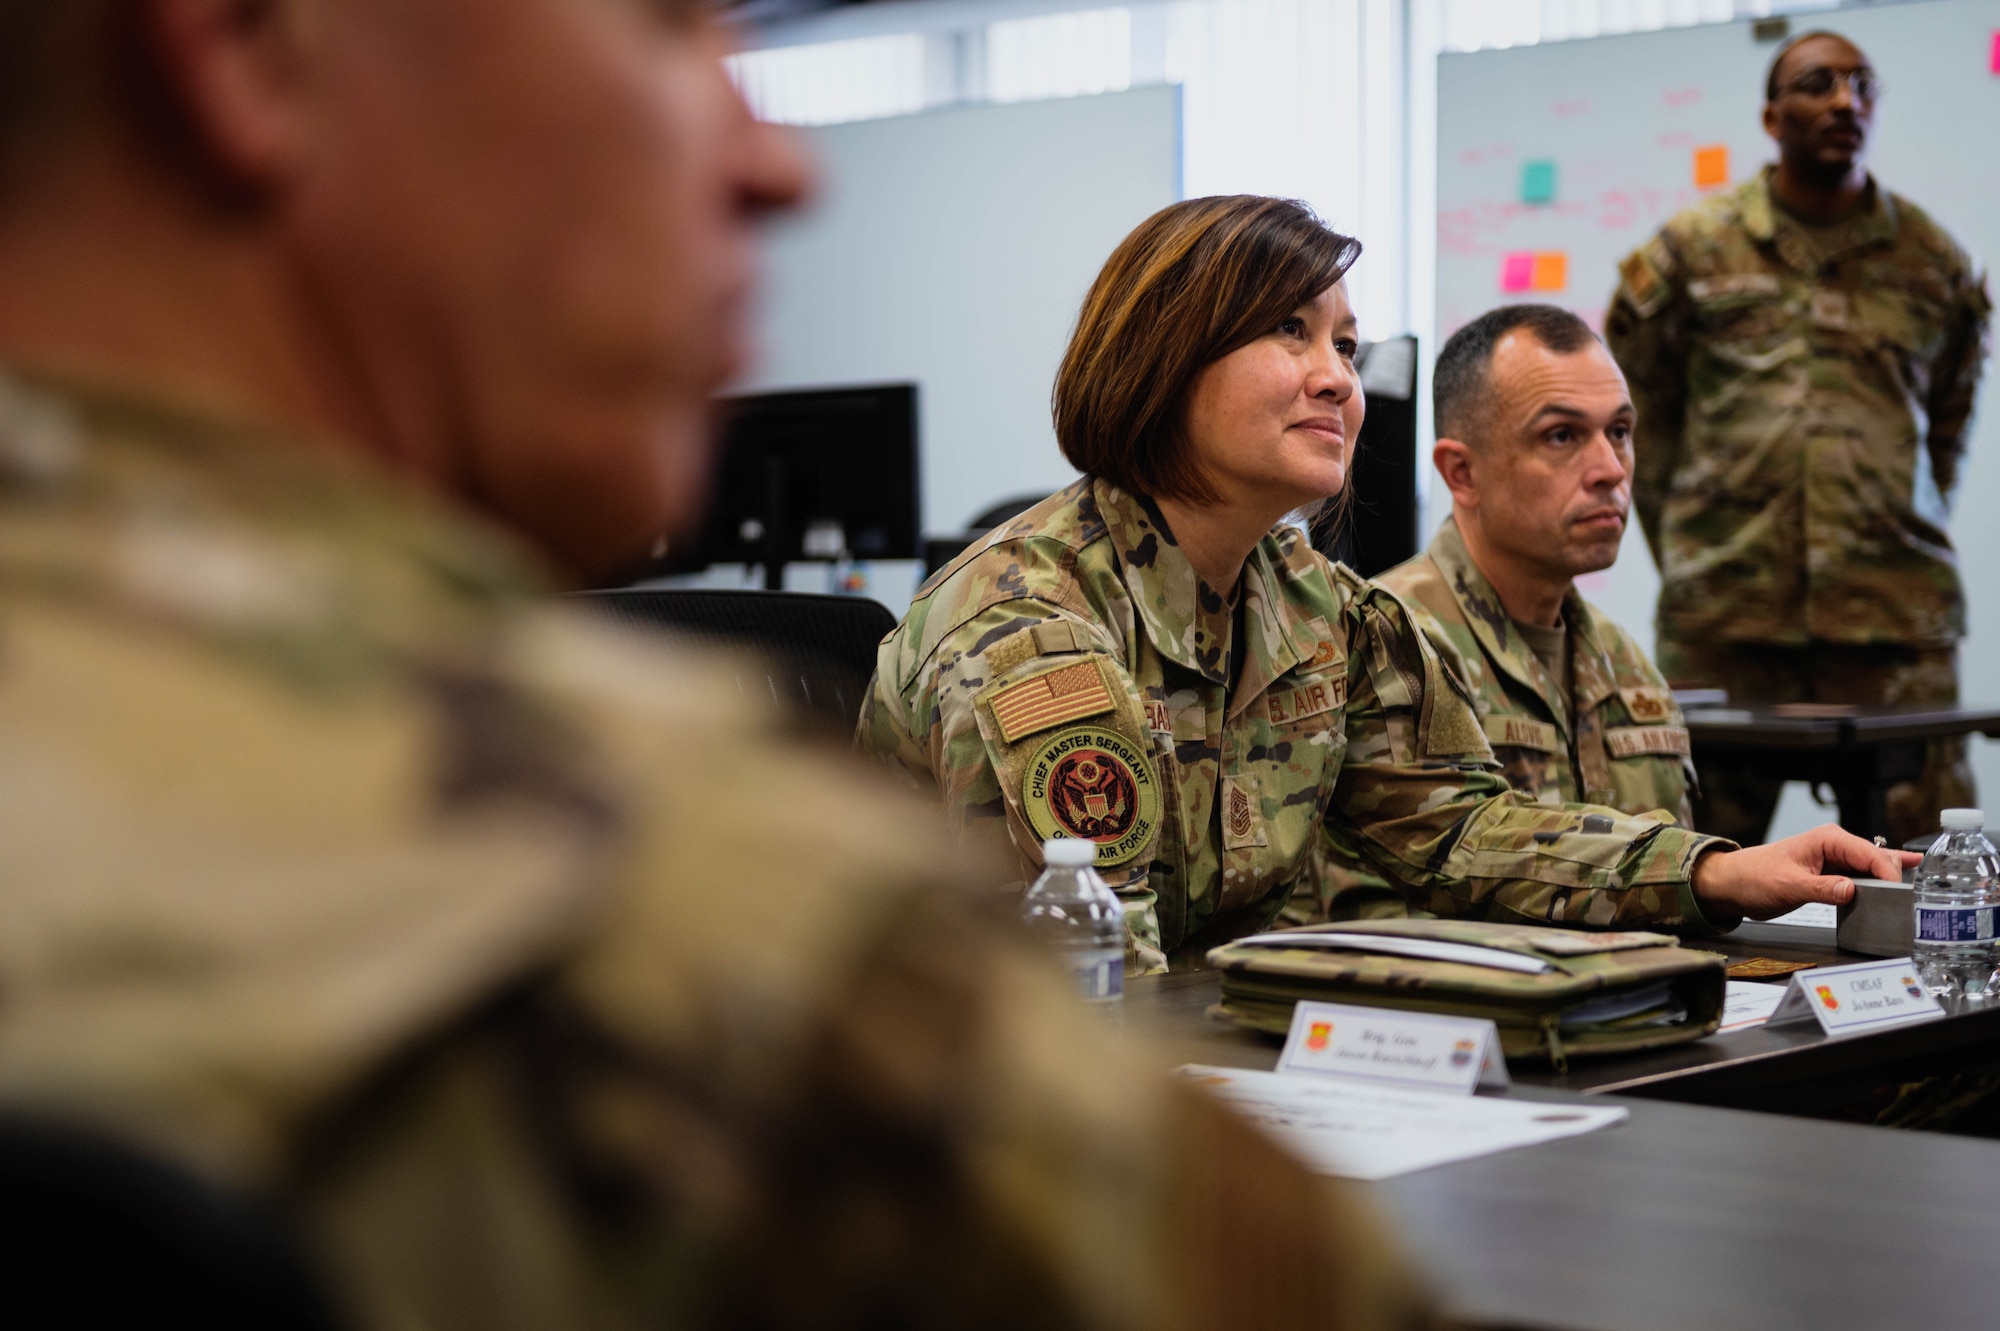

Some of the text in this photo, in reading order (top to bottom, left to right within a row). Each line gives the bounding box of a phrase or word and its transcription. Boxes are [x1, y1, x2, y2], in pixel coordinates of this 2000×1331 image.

[1294, 683, 1330, 717] AIR
[1611, 733, 1641, 754] U.S.
[1642, 730, 1663, 749] AIR
[1032, 735, 1149, 799] CHIEF MASTER SERGEANT
[1097, 847, 1118, 859] AIR
[1120, 819, 1149, 854] FORCE
